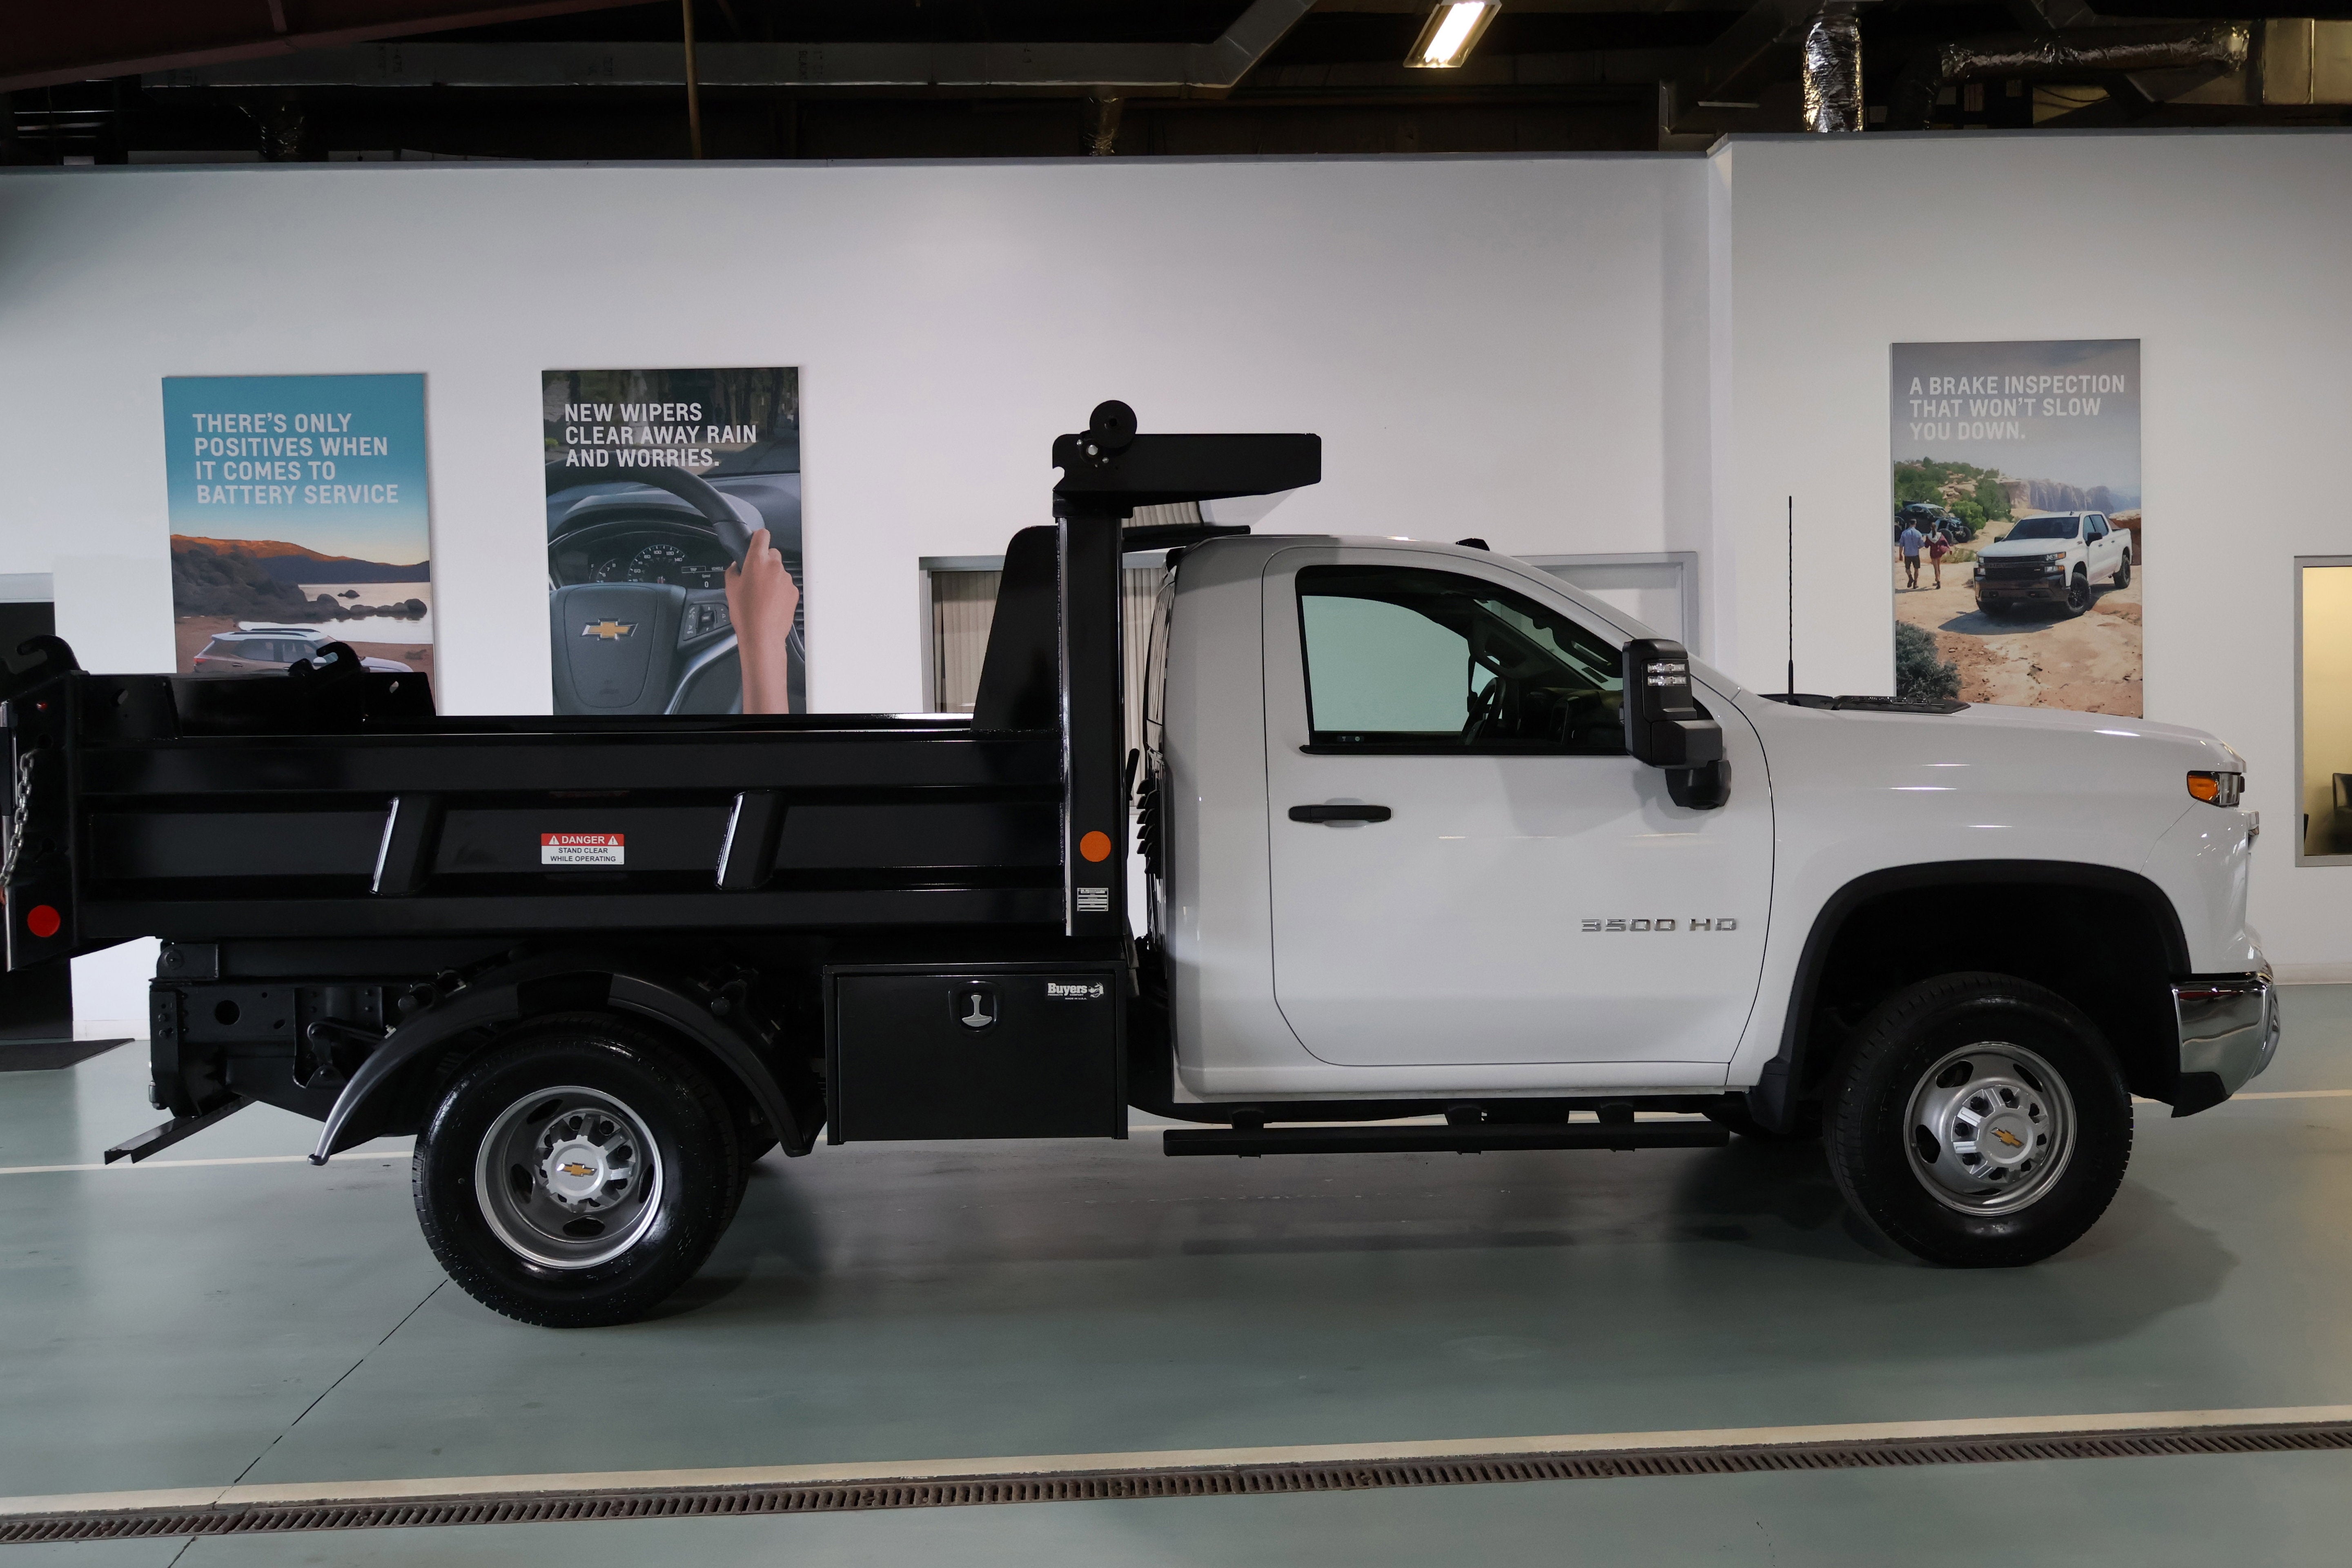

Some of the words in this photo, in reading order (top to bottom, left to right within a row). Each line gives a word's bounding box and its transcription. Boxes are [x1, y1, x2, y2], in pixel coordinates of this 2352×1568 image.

[1910, 377, 1923, 394] A
[1929, 376, 1998, 394] BRAKE
[2005, 374, 2125, 394] INSPECTION
[565, 403, 613, 422] NEW
[621, 403, 702, 421] WIPERS
[1910, 399, 1962, 418] THAT
[1969, 398, 2036, 417] WON'T
[2043, 398, 2101, 416] SLOW
[193, 412, 287, 433] THERE'S
[295, 413, 352, 432] ONLY
[1910, 422, 1951, 441] YOU
[1958, 421, 2026, 440] DOWN.
[566, 426, 633, 444] CLEAR
[640, 426, 700, 444] AWAY
[707, 425, 756, 443] RAIN
[195, 437, 312, 457] POSITIVES
[320, 437, 388, 456] WHEN
[566, 449, 609, 467] AND
[616, 448, 719, 467] WORRIES.
[196, 461, 216, 480] IT
[223, 461, 301, 481] COMES
[308, 461, 336, 480] TO
[197, 485, 296, 504] BATTERY
[304, 484, 399, 503] SERVICE
[561, 836, 605, 844] DANGER
[1581, 918, 1675, 931] 3500
[1689, 918, 1736, 931] HD
[1048, 983, 1087, 996] Buyers
